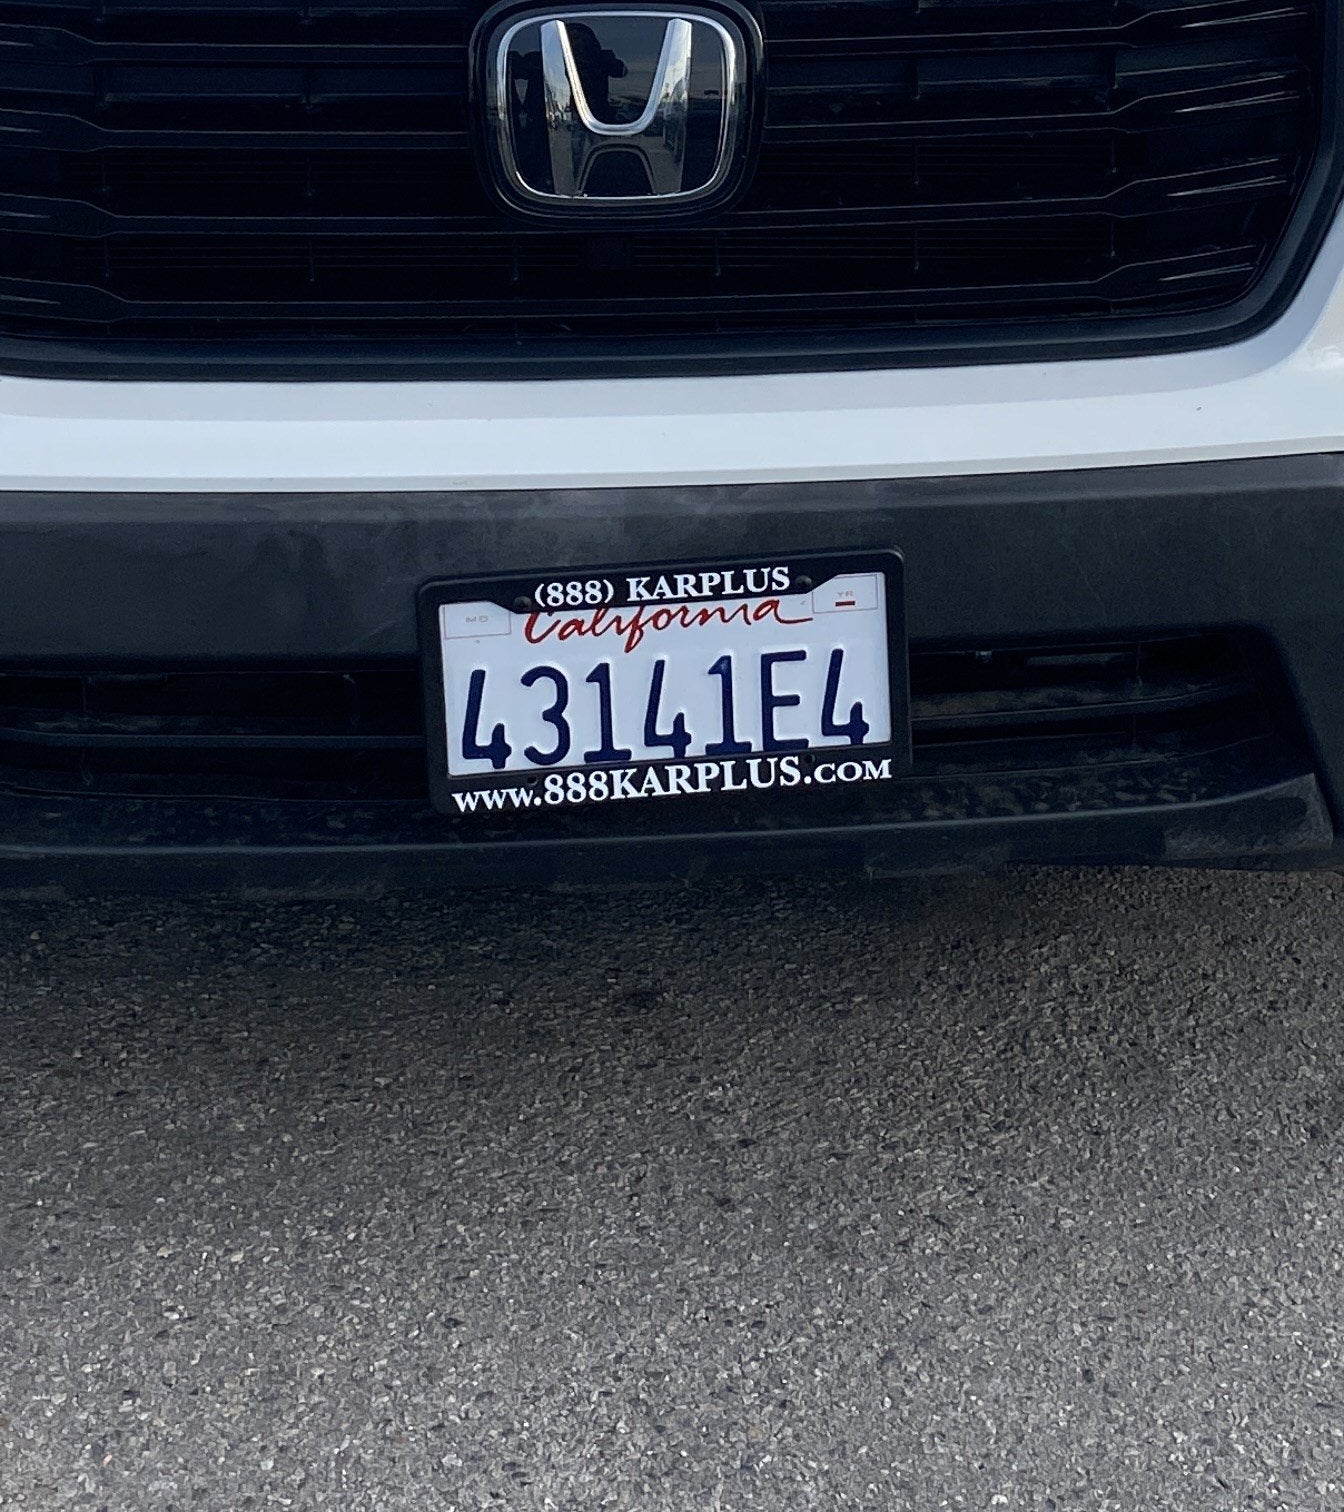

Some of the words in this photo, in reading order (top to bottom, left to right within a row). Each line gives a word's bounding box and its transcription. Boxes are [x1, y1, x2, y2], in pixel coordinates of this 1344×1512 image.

[535, 578, 615, 608] (888)
[626, 566, 791, 603] KARPLUS
[523, 596, 814, 654] California
[460, 648, 871, 771] 43141E4
